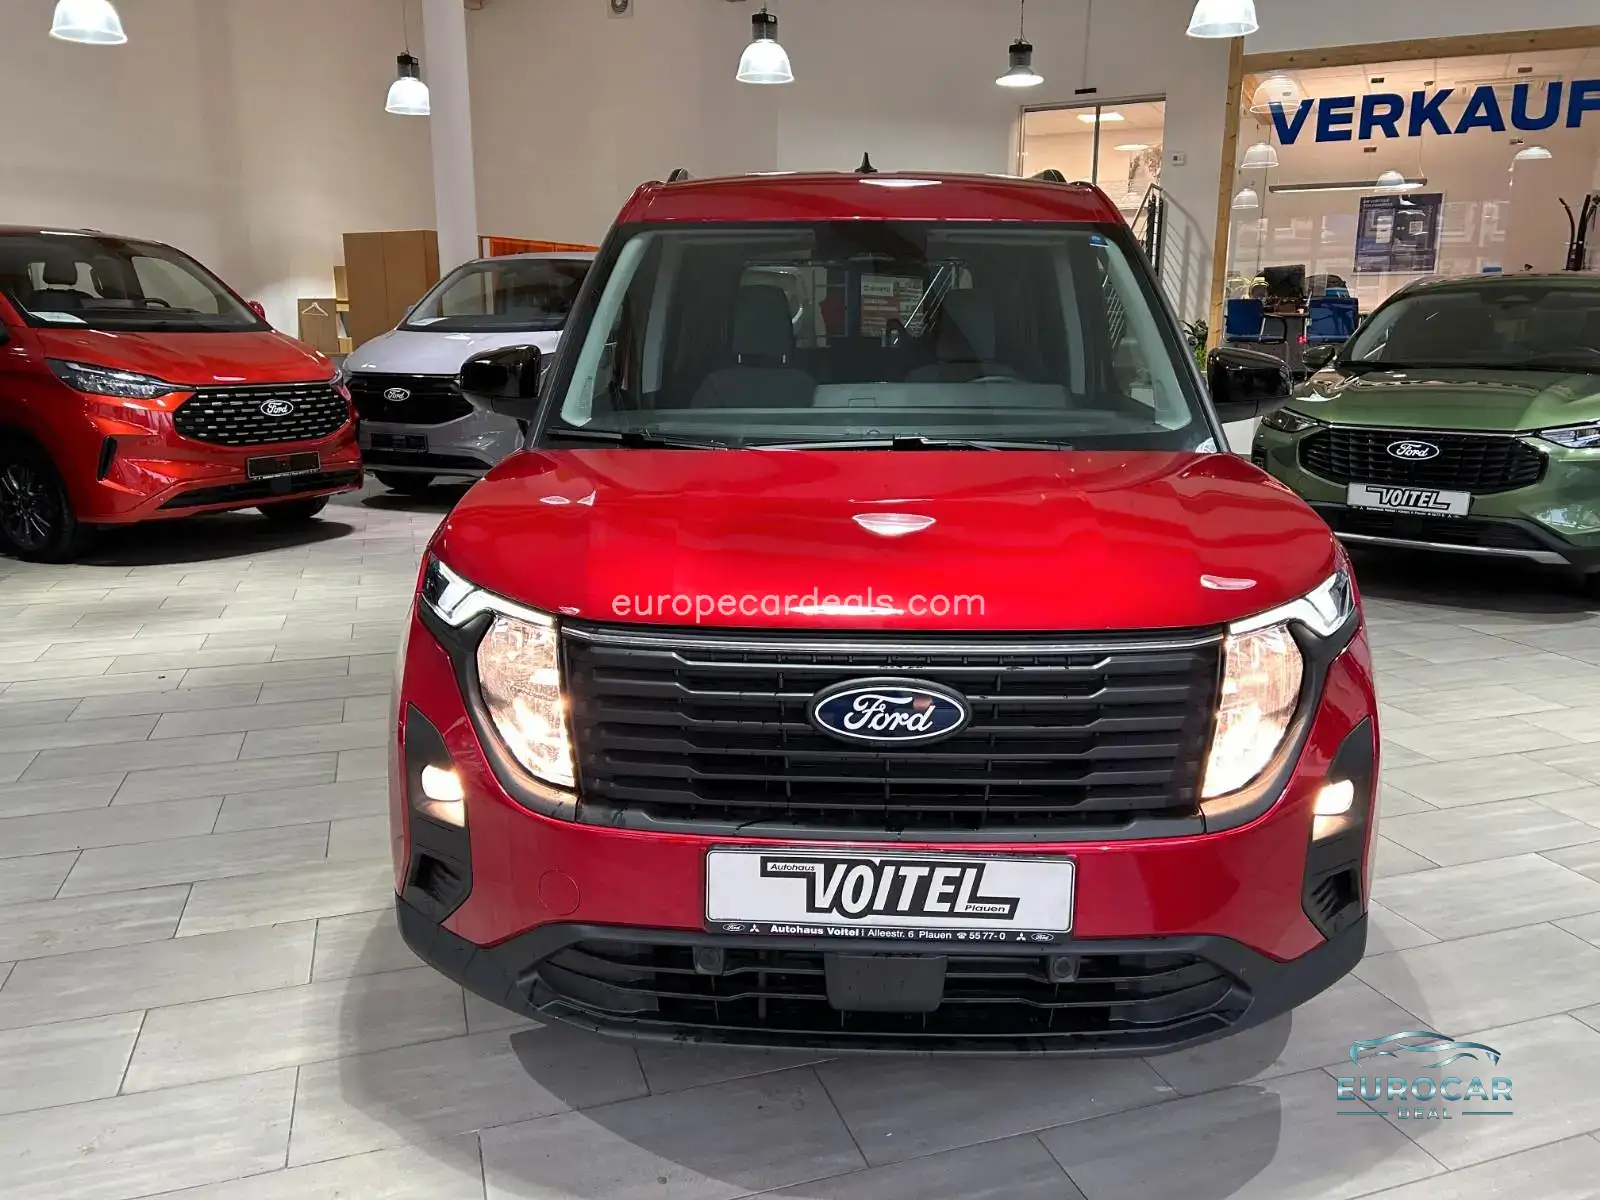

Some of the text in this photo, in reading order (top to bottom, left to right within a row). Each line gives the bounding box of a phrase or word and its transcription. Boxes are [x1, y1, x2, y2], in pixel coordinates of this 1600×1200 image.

[1268, 80, 1600, 145] VERKAUF
[387, 388, 405, 399] Ford
[267, 402, 288, 414] Ford
[1396, 443, 1429, 457] Ford
[1381, 489, 1437, 507] VOITEL
[843, 694, 936, 732] Ford
[770, 862, 816, 873] Autohaus
[814, 863, 978, 915] VOITEL
[964, 903, 1007, 915] Plauen
[770, 924, 824, 936] Autohaus
[827, 927, 859, 937] Voitel
[867, 929, 905, 939] Alleestr.
[907, 930, 914, 939] 6
[919, 931, 952, 941] Plauen
